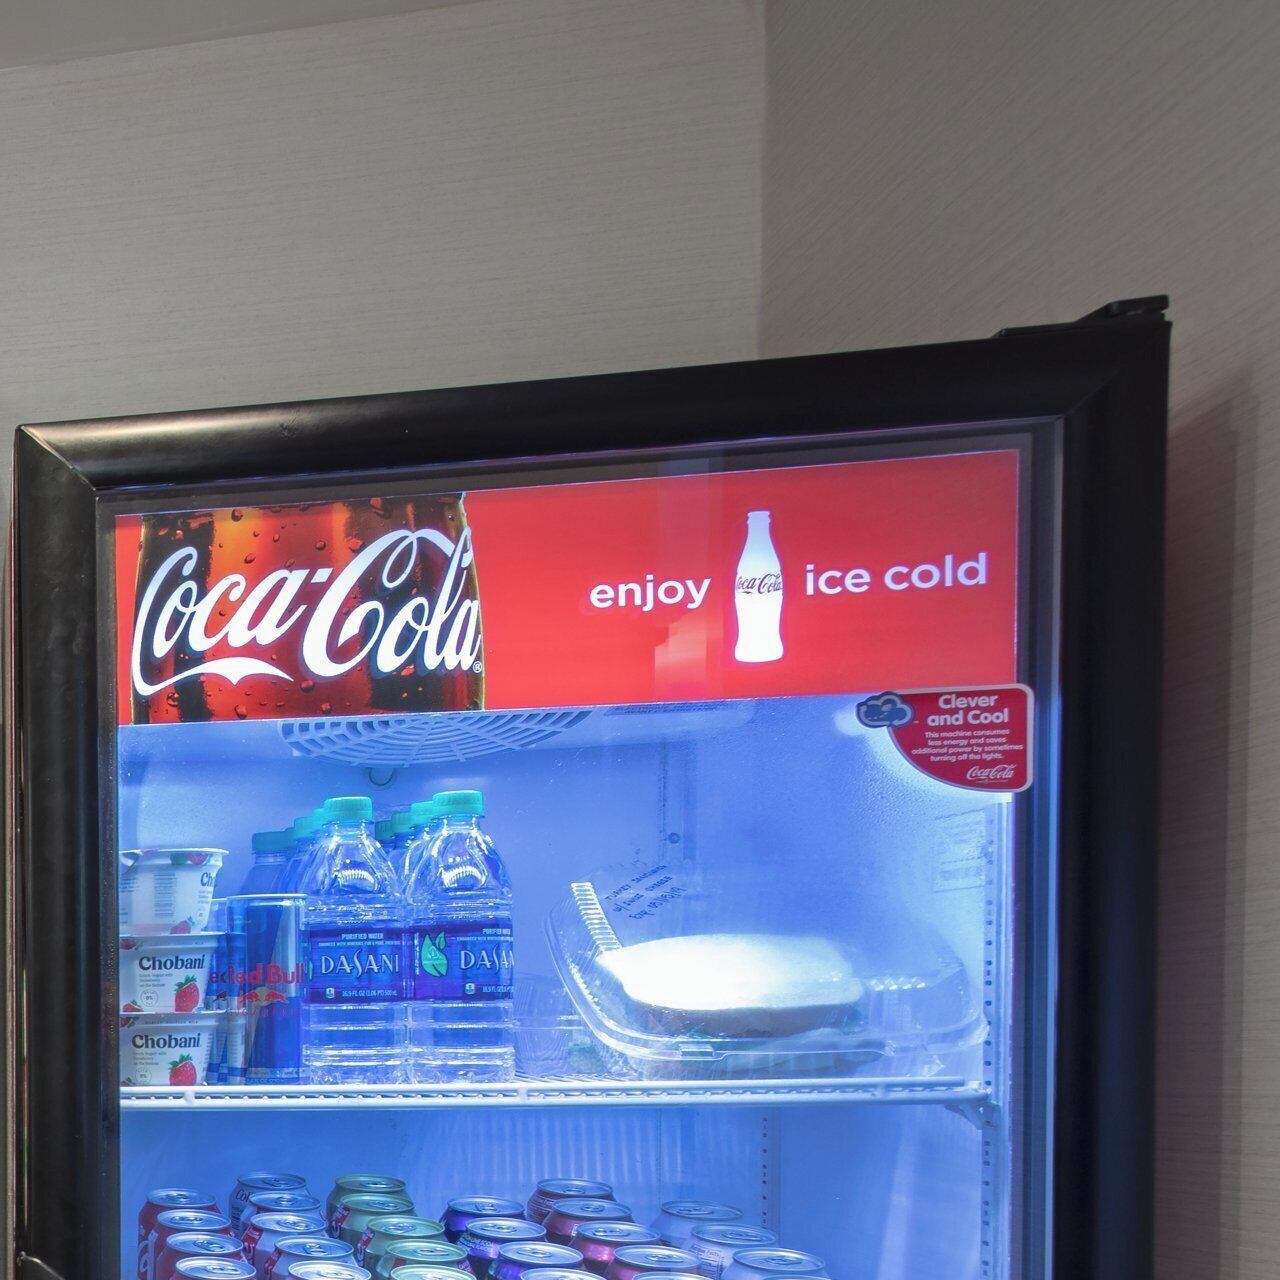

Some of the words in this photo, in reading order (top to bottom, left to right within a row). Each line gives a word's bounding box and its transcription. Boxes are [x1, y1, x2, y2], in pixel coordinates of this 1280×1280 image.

[804, 562, 871, 597] ice
[883, 552, 989, 591] cold
[588, 573, 712, 612] enjoy
[130, 526, 482, 697] Coca-Cola
[938, 694, 998, 709] Clever
[927, 710, 963, 726] and
[967, 708, 1008, 724] Cool
[941, 730, 972, 738] machine
[973, 728, 1010, 736] consumes
[966, 764, 1017, 780] Coca-Cola
[138, 953, 206, 972] Chobani
[320, 948, 400, 977] DASANI
[132, 1032, 202, 1050] Chobani
